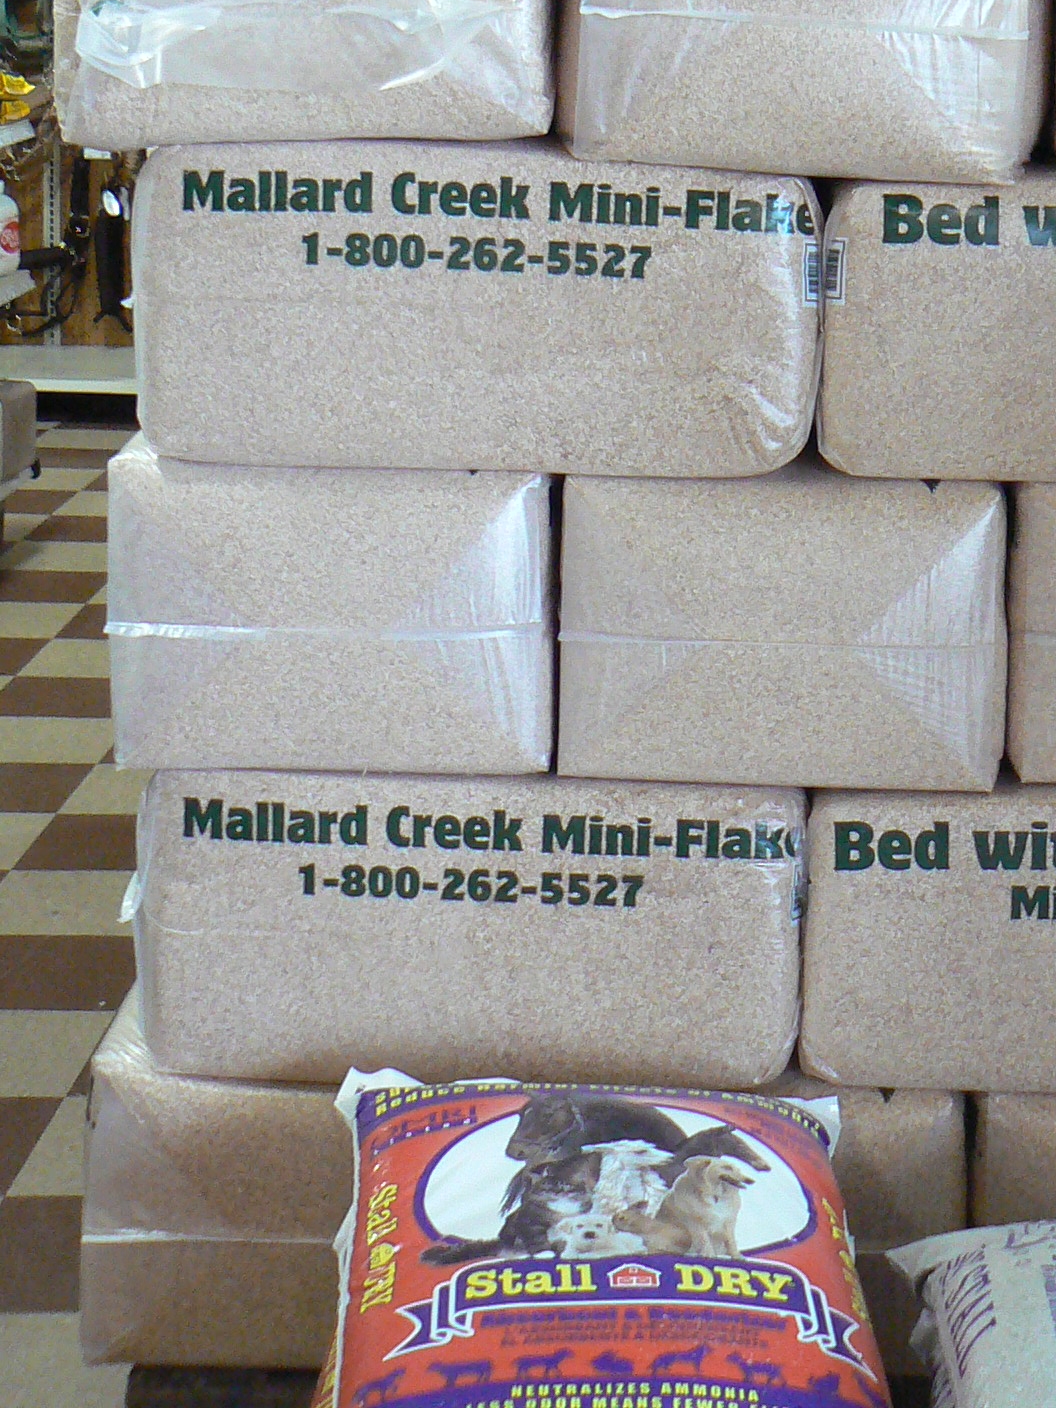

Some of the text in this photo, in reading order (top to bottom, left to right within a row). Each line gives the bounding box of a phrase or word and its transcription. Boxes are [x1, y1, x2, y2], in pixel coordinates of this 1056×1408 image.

[182, 170, 374, 214] Mallard
[390, 174, 531, 220] Creek
[881, 193, 1000, 247] Bed
[300, 231, 653, 280] 1-800-262-5527
[183, 796, 370, 847] Mallard
[385, 805, 524, 853] Creek
[833, 821, 951, 872] Bed
[299, 863, 646, 909] 1-800-262-5527
[464, 1263, 794, 1302] Stall DRY
[511, 1381, 760, 1403] NEUTRALIZES AMMONIA
